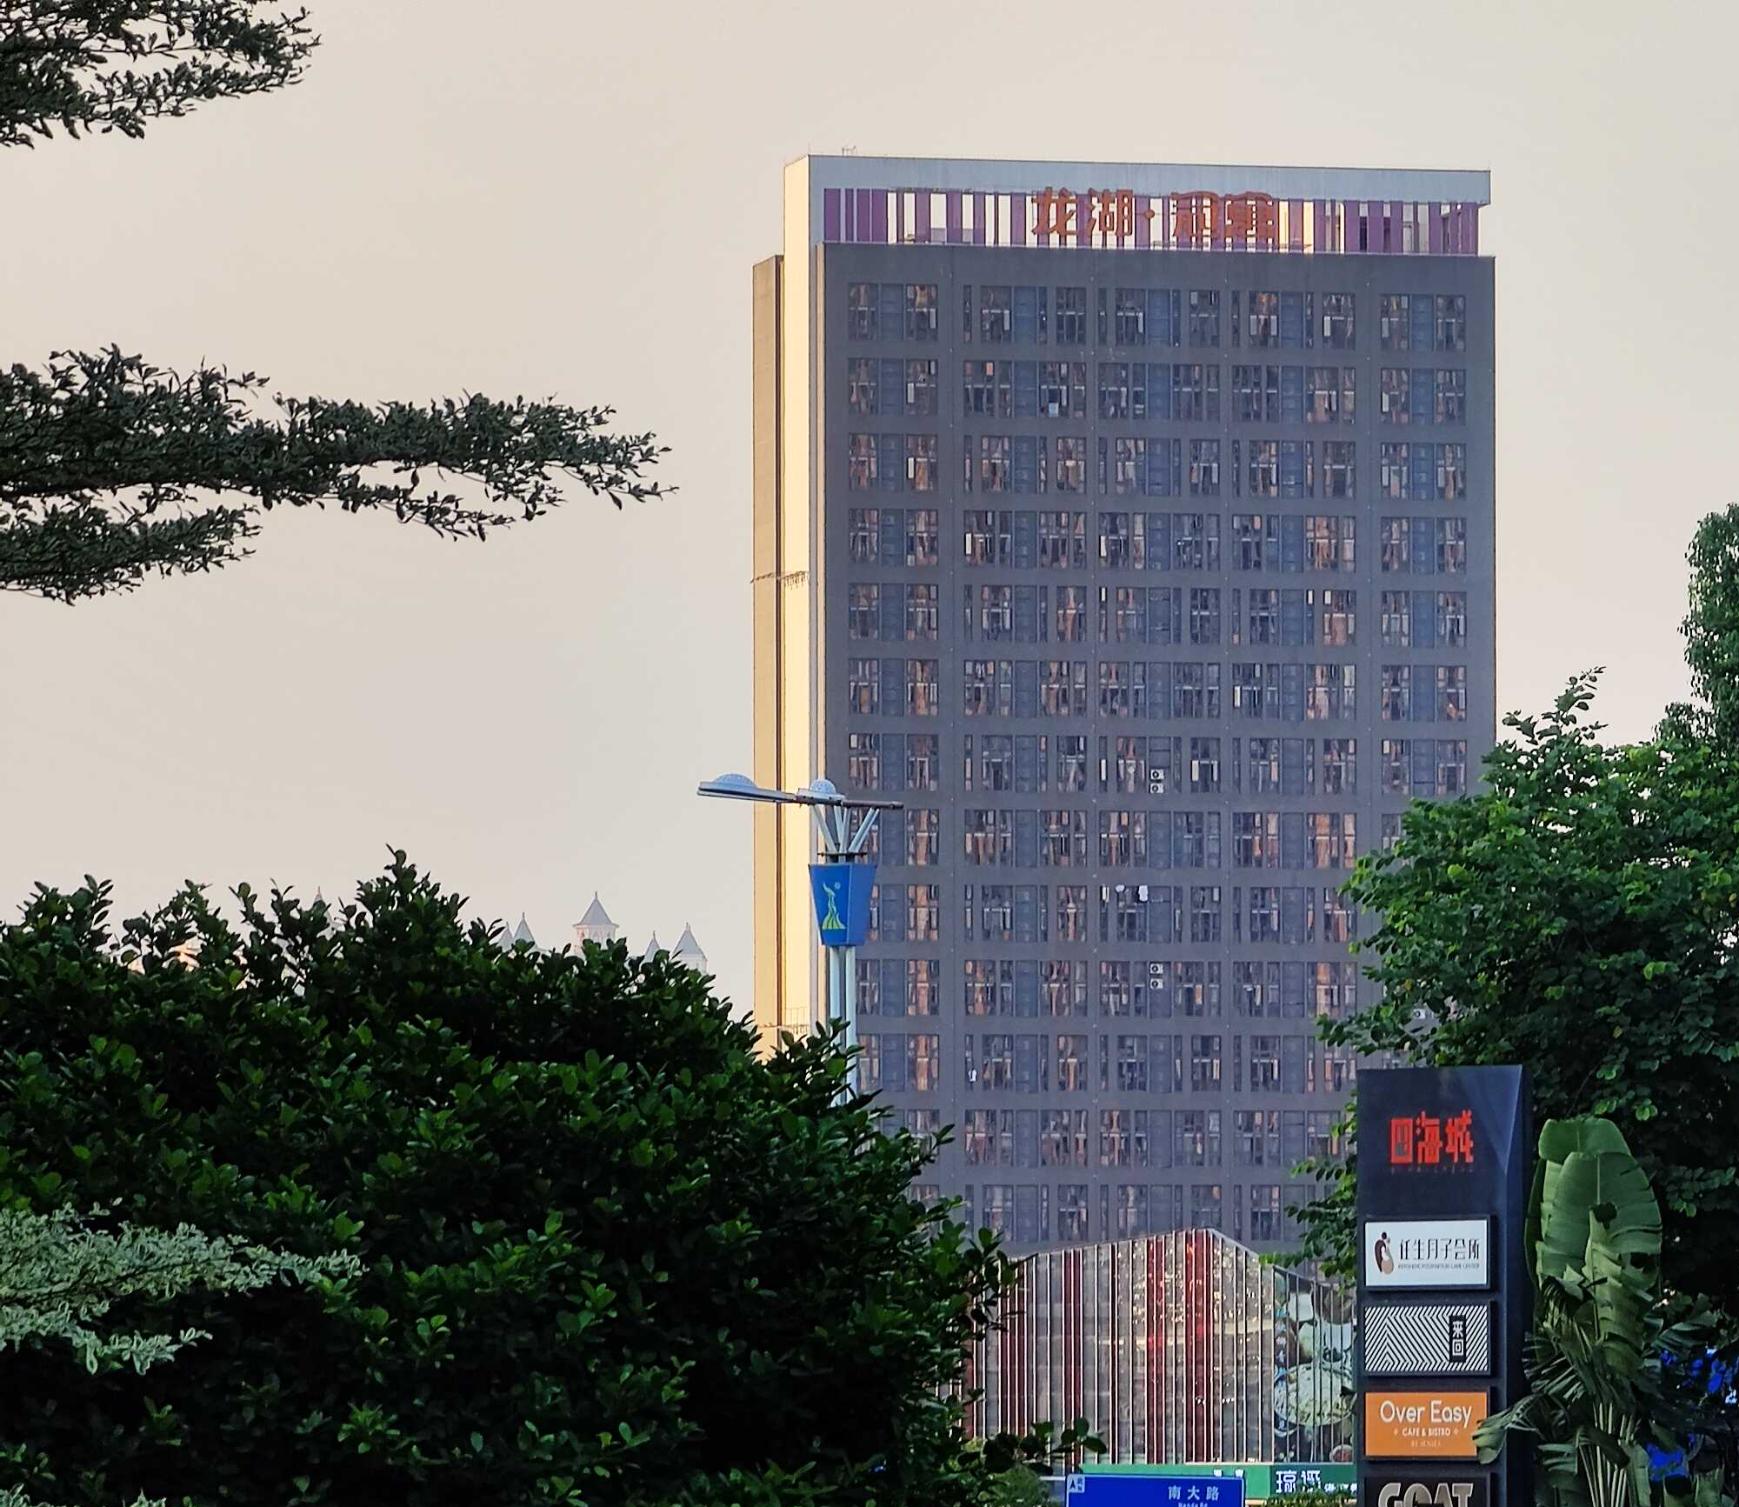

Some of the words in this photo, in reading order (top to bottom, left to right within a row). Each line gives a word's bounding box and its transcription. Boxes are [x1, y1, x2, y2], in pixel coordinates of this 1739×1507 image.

[1380, 1400, 1425, 1424] Over
[1430, 1399, 1472, 1429] Easy
[1168, 1485, 1220, 1501] 南大路
